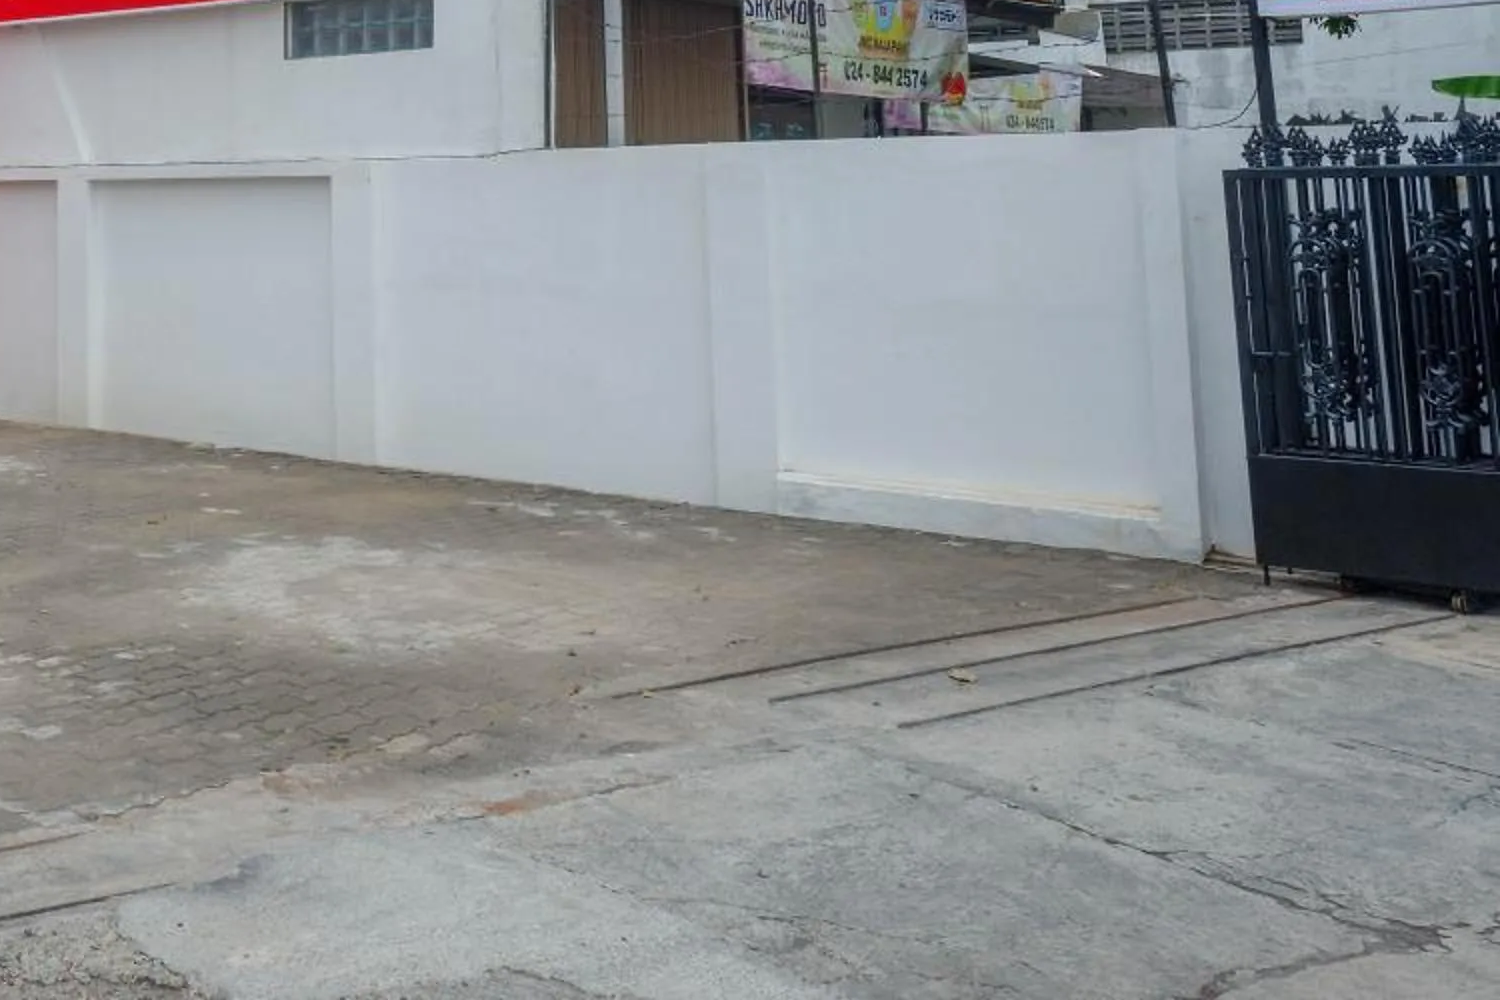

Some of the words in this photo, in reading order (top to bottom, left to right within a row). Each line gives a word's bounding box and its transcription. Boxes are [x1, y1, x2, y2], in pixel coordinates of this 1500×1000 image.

[844, 59, 863, 82] 024
[873, 64, 893, 86] 844
[896, 68, 928, 90] 2574
